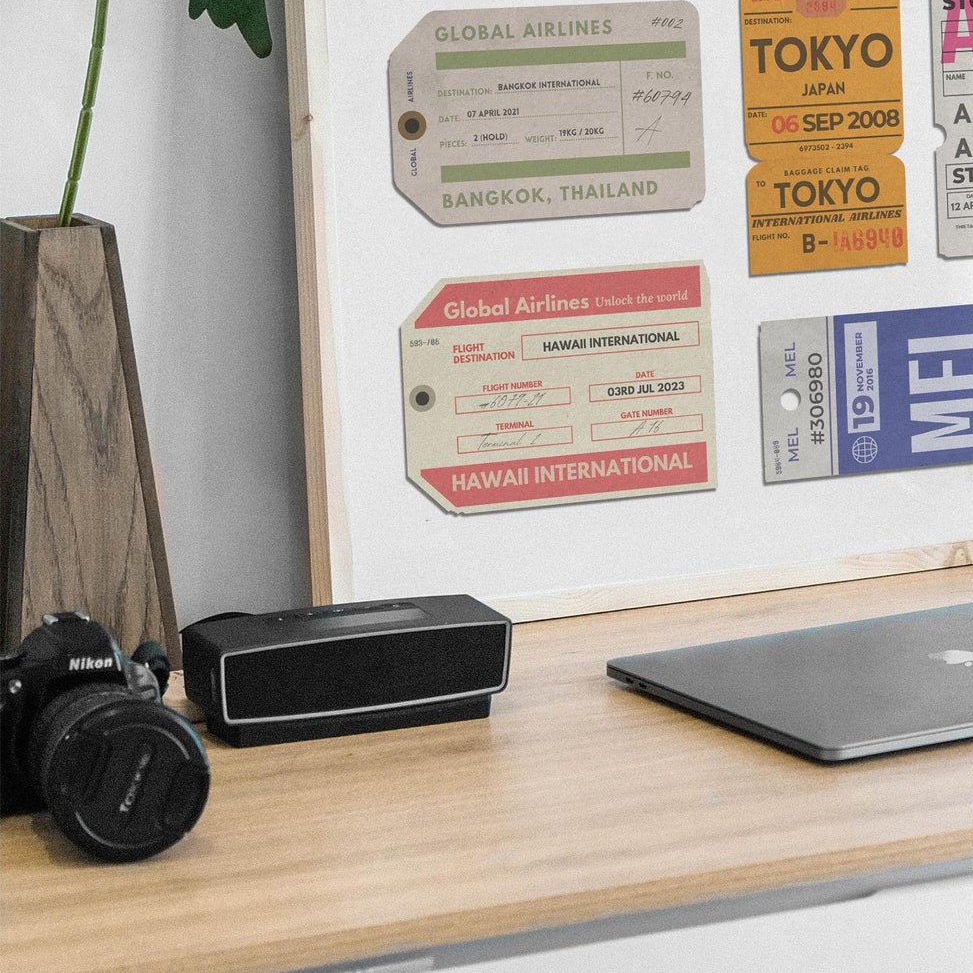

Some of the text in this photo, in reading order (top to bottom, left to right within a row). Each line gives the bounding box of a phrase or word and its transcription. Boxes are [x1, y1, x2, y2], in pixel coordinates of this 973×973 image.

[745, 17, 792, 25] DESTINATION:
[435, 19, 612, 42] GLOBAL AIRLINES
[750, 33, 893, 73] TOKYO
[438, 88, 492, 97] DESTINATION:
[498, 79, 600, 91] BANGKOK INTERNATIONAL
[802, 82, 845, 96] JAPAN
[479, 108, 519, 117] APRIL 2021
[953, 103, 971, 124] A
[772, 115, 799, 134] 06
[803, 112, 844, 132] SEP
[848, 109, 900, 129] 2008
[584, 127, 604, 135] 20KG
[440, 135, 557, 148] PIECES: WEIGHT:
[955, 138, 972, 158] A
[442, 181, 658, 209] BANGKOK, THAILAND
[774, 177, 880, 208] TOKYO
[951, 203, 960, 211] 12
[752, 210, 902, 227] INTERNATIONAL AIRLINES
[444, 294, 590, 320] Global Airlines
[595, 290, 688, 308] Unlock the world
[453, 343, 484, 353] FLIGHT
[542, 331, 680, 353] HAWAII INTERNATIONAL
[453, 352, 515, 364] DESTINATION
[483, 380, 543, 392] FLIGHT NUMBER
[852, 332, 875, 429] 19 NOVEMBER
[866, 369, 874, 391] 2016
[608, 382, 685, 397] 03RD JUL 2023
[785, 342, 800, 462] MEL MEL
[808, 353, 824, 444] #306980
[621, 408, 673, 419] GATE NUMBER
[496, 421, 534, 430] TERMINAL
[452, 451, 694, 493] HAWAII INTERNATIONAL
[69, 658, 113, 670] Nikon
